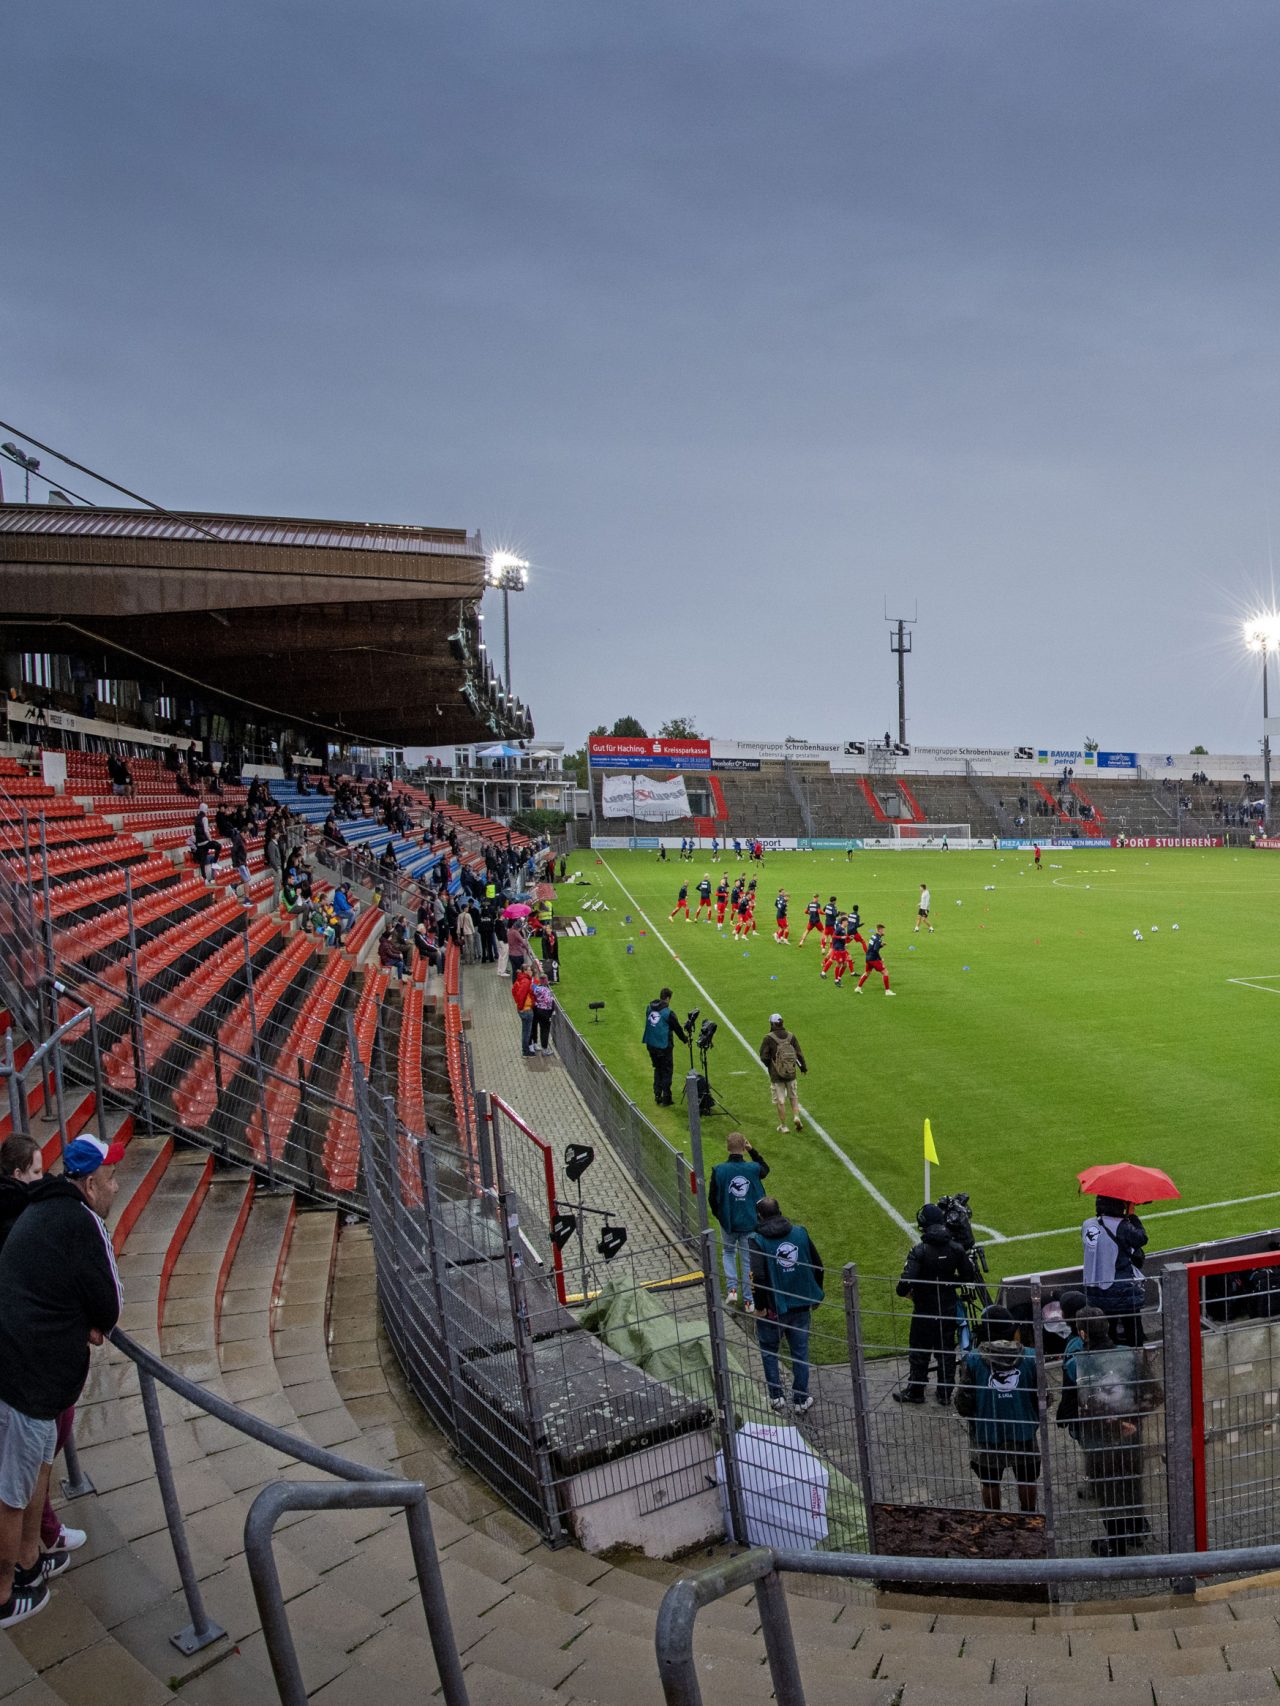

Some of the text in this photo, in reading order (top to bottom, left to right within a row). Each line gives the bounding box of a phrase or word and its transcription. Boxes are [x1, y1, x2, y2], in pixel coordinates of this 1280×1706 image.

[592, 744, 647, 755] Gut für Haching.
[664, 746, 708, 756] Kreissparkasse
[737, 742, 840, 752] Firmengruppe Schrobenhauser
[914, 747, 1010, 756] Firmengruppe Schrobenhauser
[1054, 758, 1076, 766] petrol
[1116, 838, 1217, 848] SPORT STUDIEREN?
